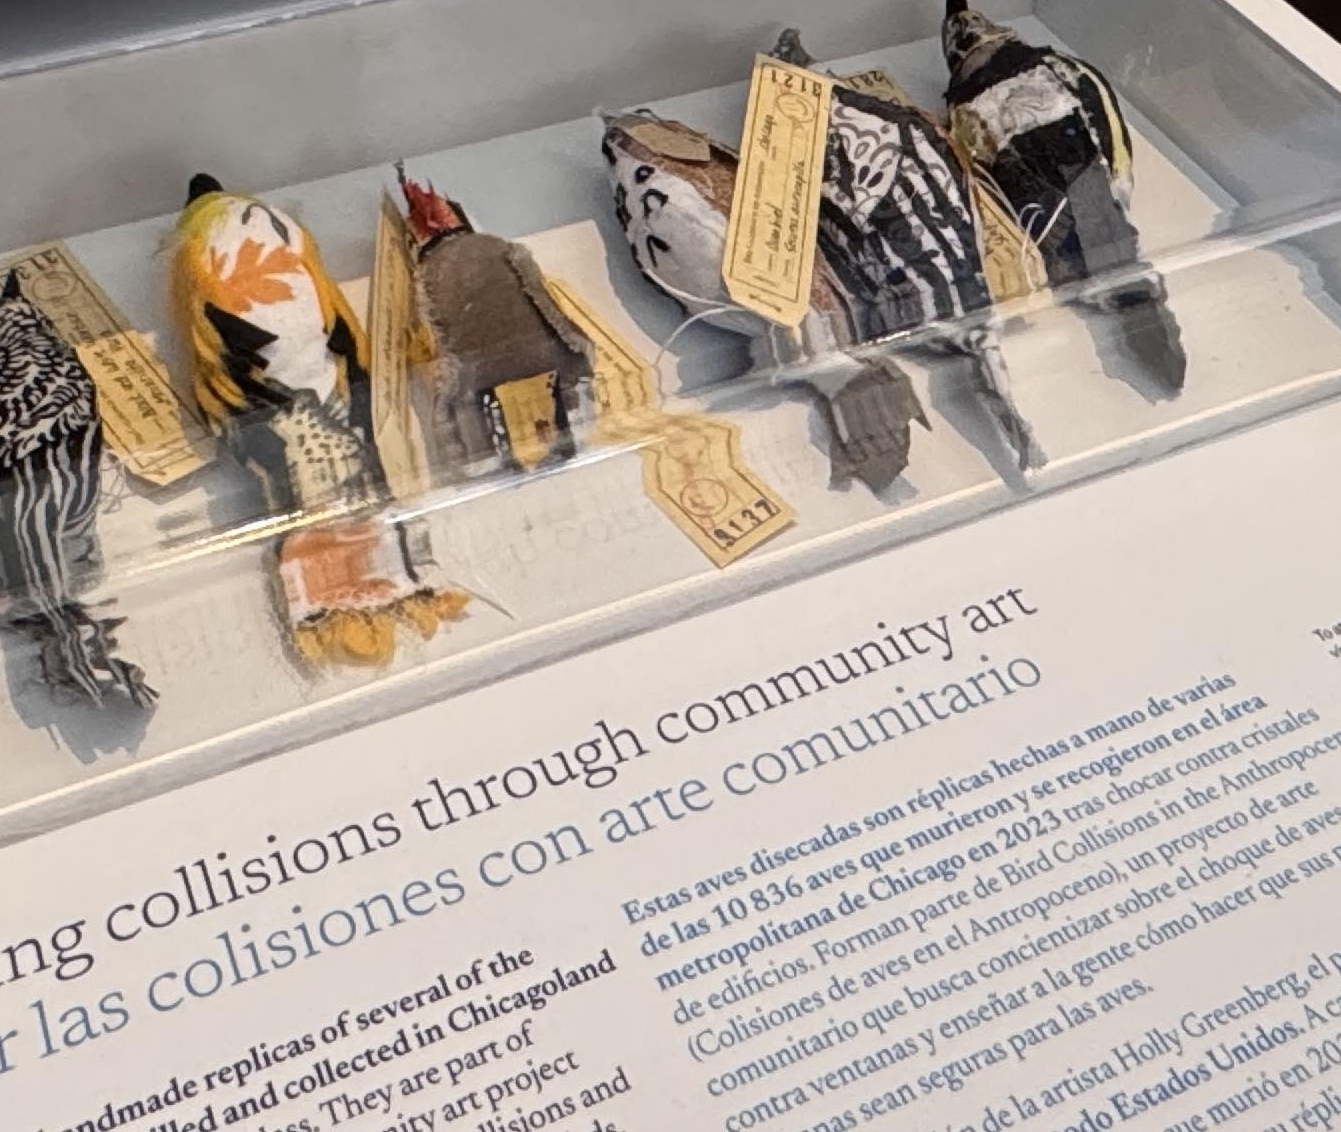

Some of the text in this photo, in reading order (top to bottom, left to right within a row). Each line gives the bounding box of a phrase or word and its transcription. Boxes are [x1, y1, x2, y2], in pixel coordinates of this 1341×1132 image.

[29, 991, 130, 1059] las
[147, 868, 466, 1012] colisiones
[479, 825, 595, 888] con
[598, 779, 715, 844] arte
[722, 654, 1041, 796] comunitario
[106, 812, 402, 942] collisions
[410, 719, 651, 832] through
[656, 614, 954, 744] community
[961, 588, 1038, 634] art
[620, 674, 1237, 926] Estas aves disecadas son réplicas hechas mano de varias
[639, 696, 1269, 958] de las 10 836 aves que murieron se recogieron en área
[654, 708, 1321, 993] metropolitana de Chicago en 2023 tras chocar contra cristales
[673, 997, 706, 1026] de
[707, 957, 817, 1011] edificios.
[810, 916, 912, 967] Forman
[908, 890, 972, 934] parte
[972, 874, 1003, 900] de
[996, 848, 1055, 889] Bird
[1051, 810, 1161, 864] Collisions
[1153, 798, 1186, 821] in
[1182, 785, 1222, 810] the
[687, 781, 1321, 1064] (Colisiones de aves en Antropoceno), un proyecto de arte
[706, 1017, 860, 1098] comunitario
[861, 999, 909, 1036] que
[901, 969, 979, 1010] busca
[976, 907, 1115, 980] concientizar
[1113, 881, 1177, 920] sobre
[1197, 838, 1276, 883] choque
[1274, 823, 1304, 848] de
[725, 1086, 811, 1132] contra
[806, 1037, 920, 1097] ventanas
[938, 986, 1031, 1040] enseñar
[1041, 967, 1074, 992] la
[1071, 941, 1136, 988] gente
[1134, 913, 1199, 952] cómo
[1190, 884, 1258, 924] hacer
[1257, 868, 1301, 900] que
[1296, 851, 1336, 879] sus
[203, 950, 535, 1092] replicas of several of the
[221, 948, 618, 1126] and collected in Chicagoland
[318, 1083, 393, 1126] They
[398, 1066, 443, 1097] are
[443, 1041, 503, 1087] part
[505, 1017, 535, 1053] of
[441, 1091, 483, 1123] art
[483, 1051, 580, 1114] project
[579, 1065, 633, 1109] and
[860, 1083, 918, 1122] sean
[916, 1042, 1009, 1096] seguras
[1006, 1017, 1065, 1063] para
[1055, 1001, 1098, 1030] las
[1095, 978, 1155, 1014] aves.
[982, 1105, 1015, 1132] de
[1007, 1093, 1042, 1121] la
[1039, 1061, 1119, 1109] artista
[1110, 1027, 1184, 1074] Holly
[1179, 972, 1312, 1039] Greenberg,
[1107, 1062, 1213, 1122] Estados
[1204, 1020, 1307, 1073] Unidos.
[1303, 1003, 1330, 1031] A
[1205, 1070, 1281, 1126] murió
[1279, 1063, 1315, 1089] en
